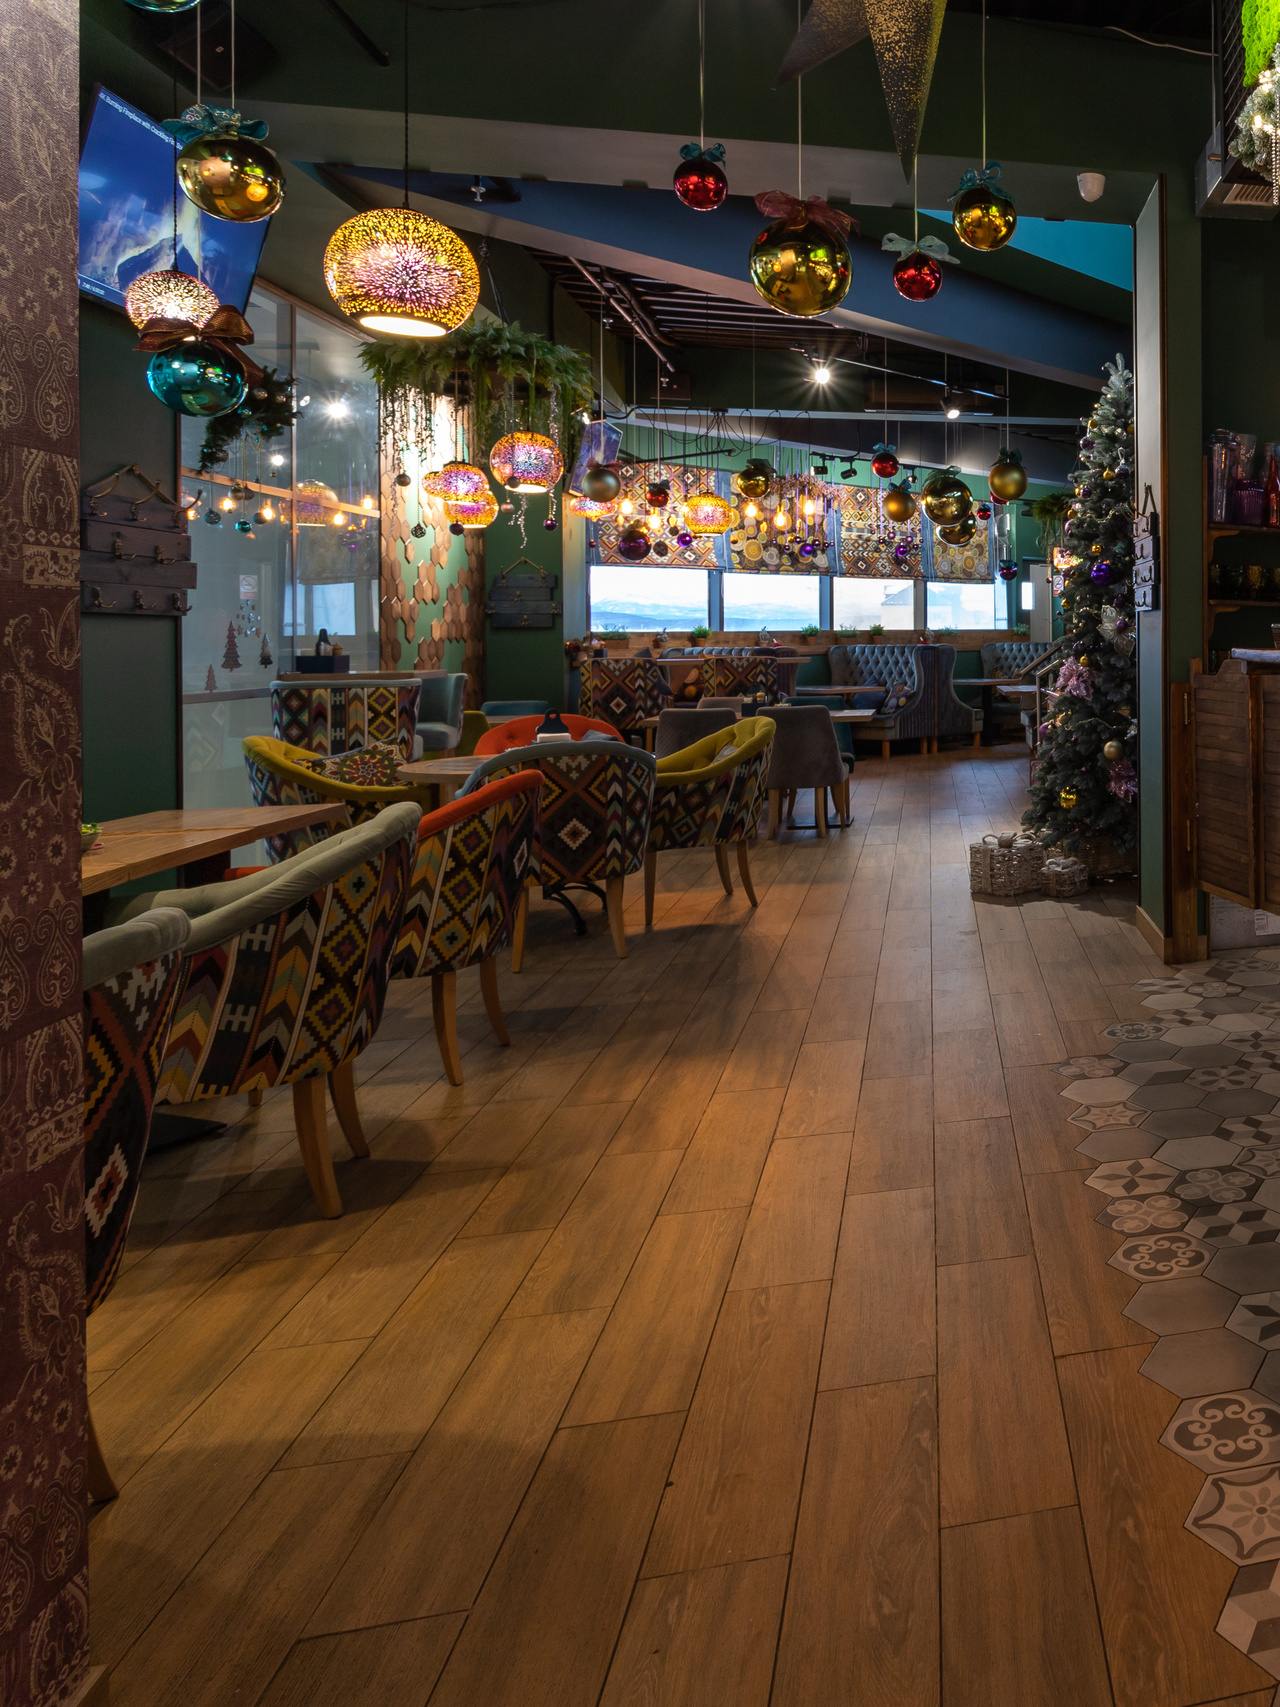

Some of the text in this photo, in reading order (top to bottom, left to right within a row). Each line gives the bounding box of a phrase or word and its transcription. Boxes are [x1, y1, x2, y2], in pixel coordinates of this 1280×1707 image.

[105, 96, 123, 113] Burning
[122, 106, 142, 125] Fireplace
[142, 121, 151, 131] with
[150, 125, 170, 143] Crackling
